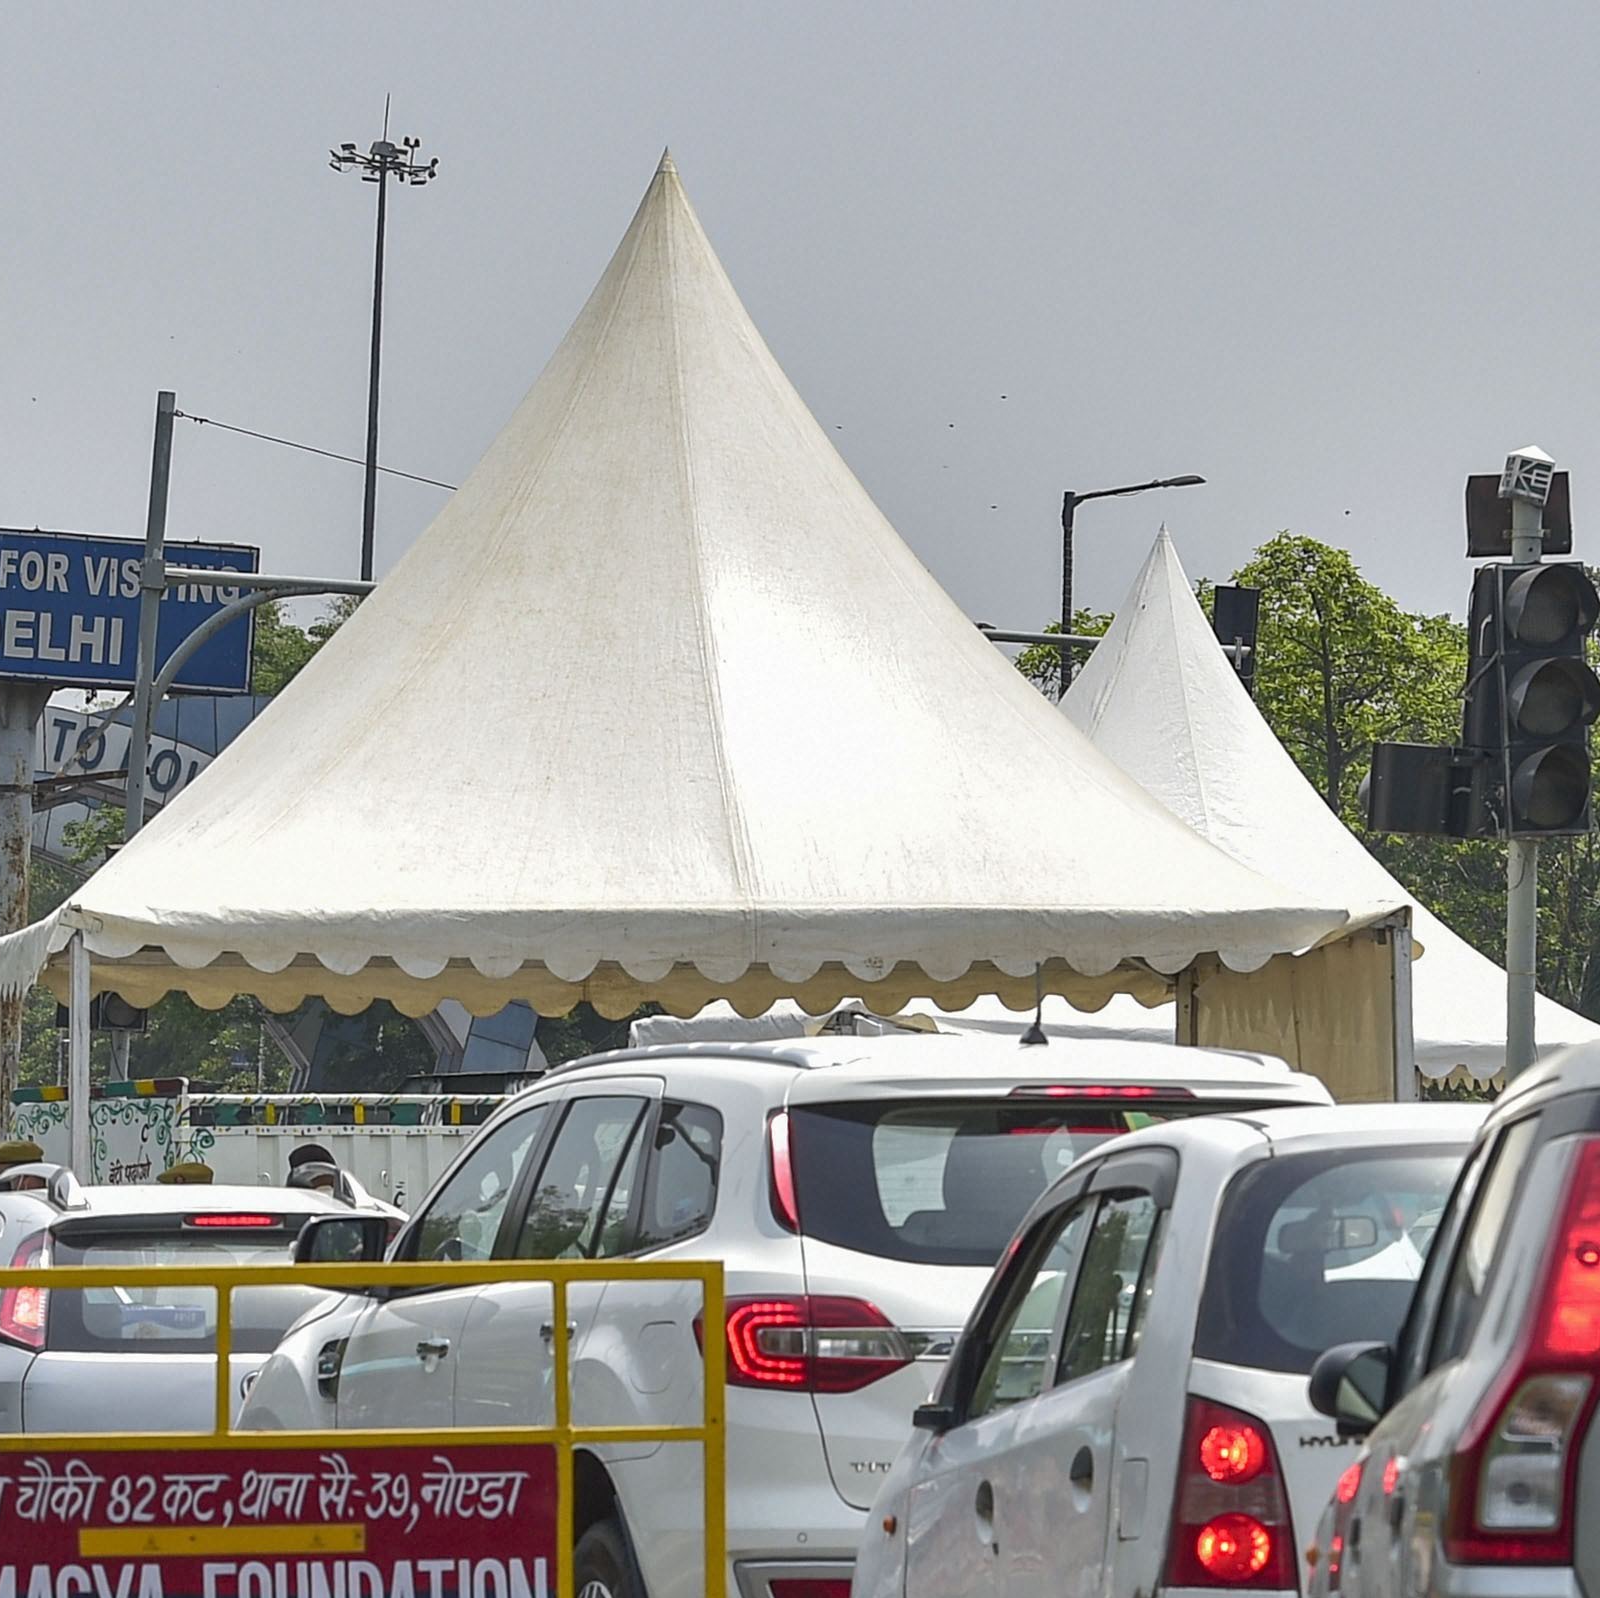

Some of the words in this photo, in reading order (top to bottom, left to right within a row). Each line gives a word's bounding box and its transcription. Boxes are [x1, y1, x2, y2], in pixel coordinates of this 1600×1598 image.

[84, 555, 242, 606] VISING
[52, 717, 107, 770] TO
[16, 1456, 106, 1524] चौकी
[106, 1474, 157, 1523] 82
